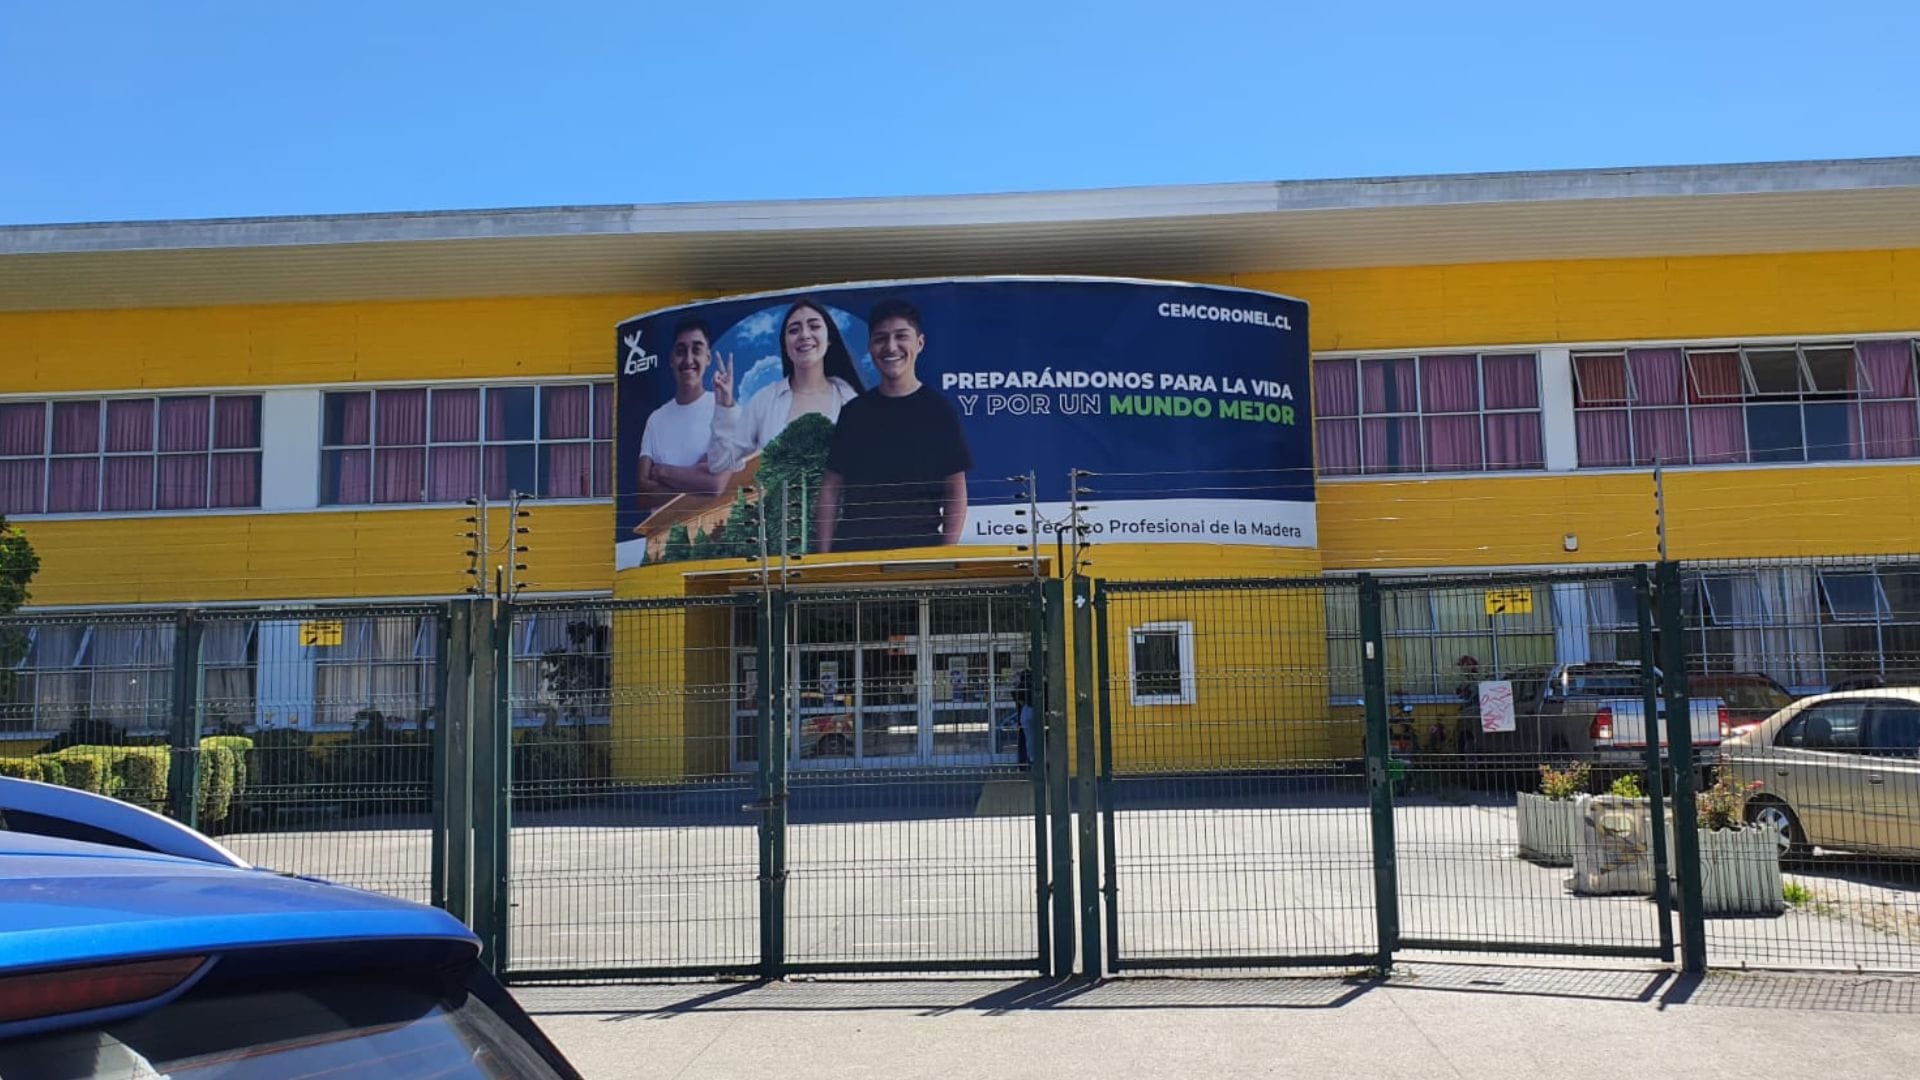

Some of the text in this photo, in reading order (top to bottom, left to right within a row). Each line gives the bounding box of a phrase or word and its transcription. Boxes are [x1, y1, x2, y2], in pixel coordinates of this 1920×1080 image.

[1158, 302, 1292, 331] CEMCORONEL.CL
[942, 367, 1294, 400] PREPARÁNDONOS PARA LA VIDA
[958, 393, 1296, 426] Y POR UN MUNDO MEJOR
[1109, 517, 1205, 534] Profesional
[1209, 519, 1230, 534] de
[1234, 519, 1247, 535] la
[1251, 521, 1302, 538] Madera
